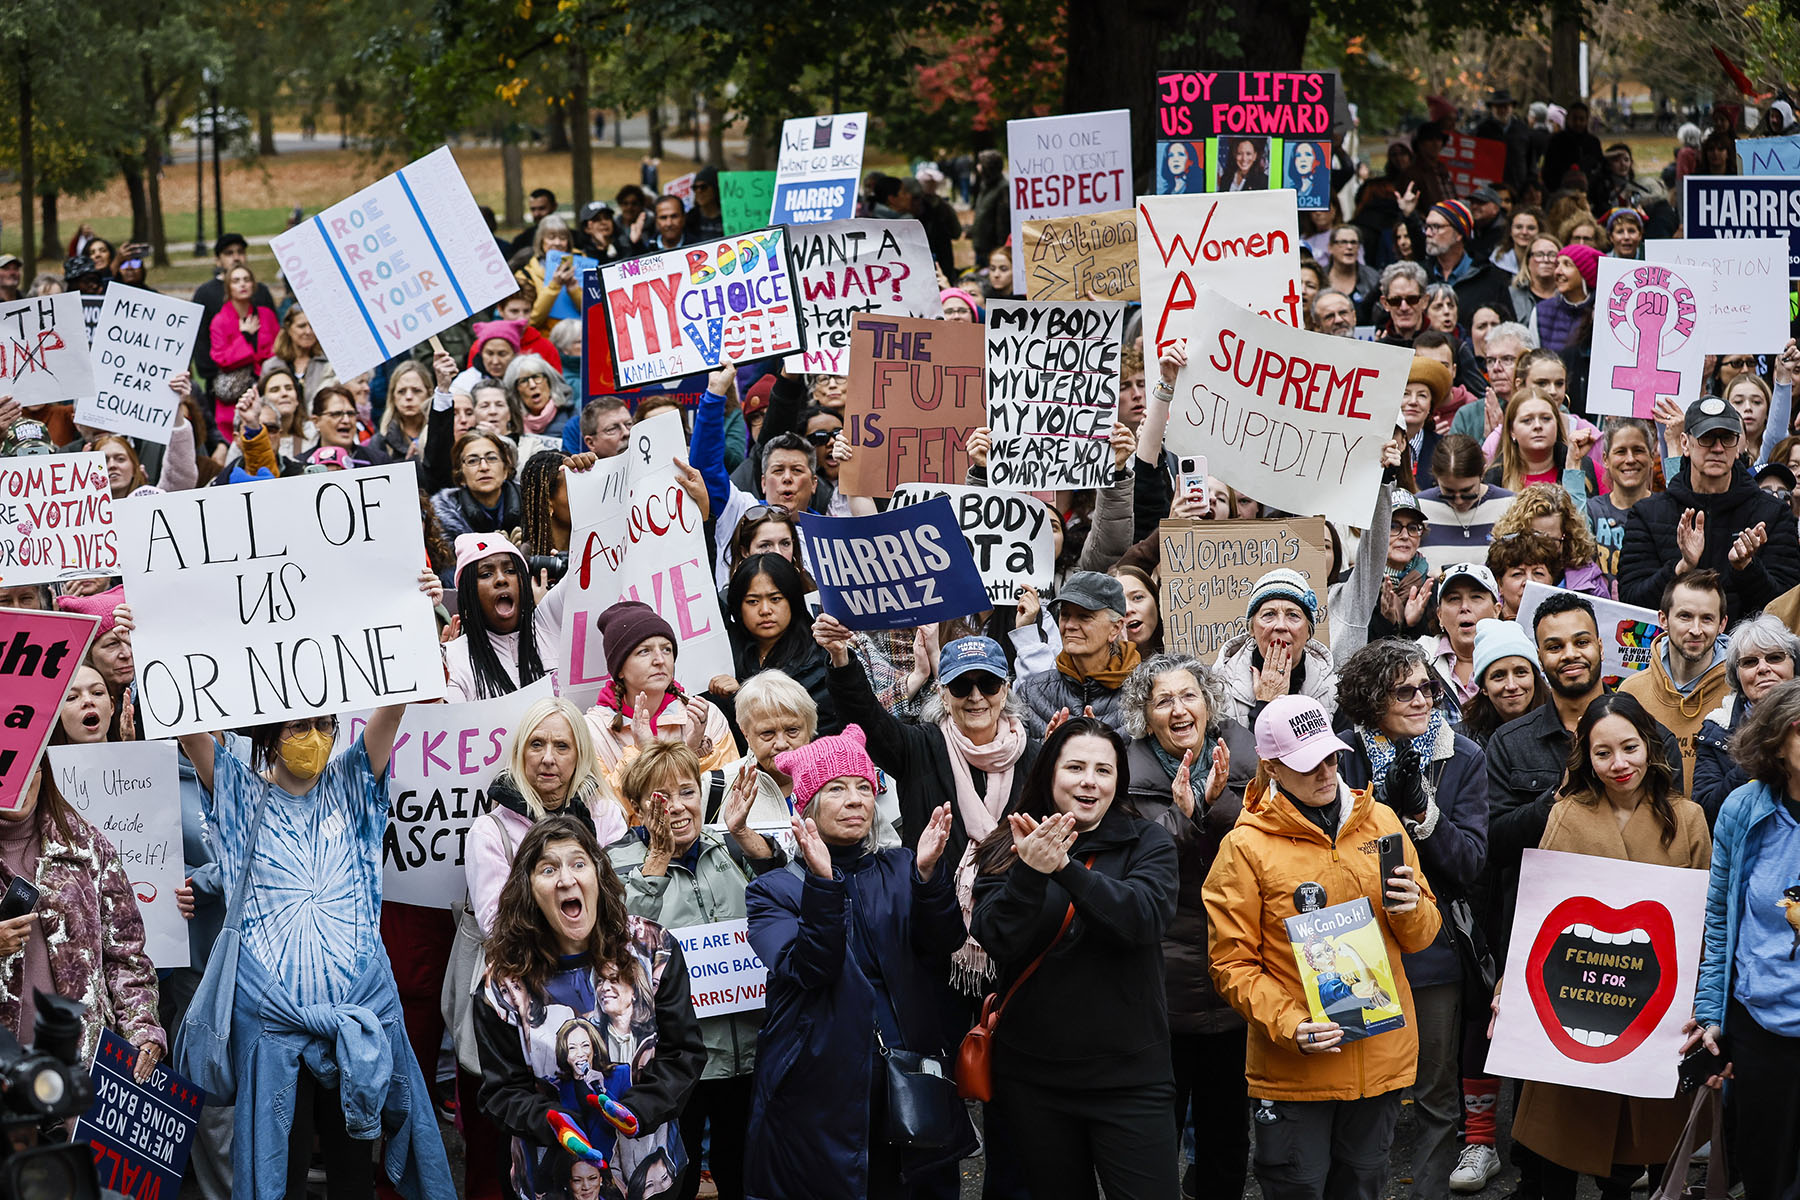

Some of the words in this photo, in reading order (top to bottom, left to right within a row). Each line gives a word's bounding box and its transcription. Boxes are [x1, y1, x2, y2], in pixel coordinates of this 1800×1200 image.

[1158, 73, 1218, 103] JOY
[1239, 72, 1323, 102] LIFTS
[1160, 106, 1193, 135] US
[1212, 104, 1329, 134] FORWARD
[785, 128, 810, 152] WE
[1037, 133, 1063, 150] NO
[1069, 131, 1101, 146] ONE
[810, 156, 827, 170] GO
[831, 153, 860, 168] BACK
[1015, 157, 1054, 175] WHO
[1063, 151, 1118, 172] DOESN'T
[785, 186, 845, 211] HARRIS
[1015, 169, 1124, 210] RESPECT
[1297, 196, 1321, 207] 024
[331, 198, 384, 239] ROE
[793, 209, 833, 223] WALZ
[344, 223, 397, 265] ROE
[877, 229, 901, 259] A
[1032, 220, 1137, 263] Action
[1139, 201, 1290, 268] Women
[275, 241, 312, 290] NOT
[357, 250, 410, 291] ROE
[474, 240, 514, 290] NOT
[685, 231, 783, 285] BODY
[371, 269, 439, 314] YOUR
[803, 261, 910, 302] WAP?
[1073, 255, 1138, 299] Fear
[115, 299, 155, 321] MEN
[166, 313, 189, 328] OF
[384, 294, 453, 340] VOTE
[608, 272, 682, 362] MY
[681, 272, 788, 321] CHOICE
[1609, 281, 1633, 328] YES
[1634, 266, 1672, 289] SHE
[1673, 287, 1697, 338] CAN
[108, 326, 184, 356] QUALITY
[683, 305, 792, 366] VOTE
[857, 320, 933, 363] THE
[991, 307, 1048, 334] MY
[1047, 307, 1120, 341] BODY
[101, 350, 125, 368] DO
[137, 362, 172, 380] NOT
[624, 358, 668, 384] KAMALA
[669, 355, 684, 374] 24
[803, 348, 843, 372] MY
[989, 336, 1028, 365] MY
[1026, 339, 1119, 373] CHOICE
[113, 372, 151, 392] FEAR
[872, 361, 985, 411] FUT
[989, 368, 1024, 400] MY
[1025, 370, 1118, 408] UTERUS
[1209, 329, 1379, 420] SUPREME
[96, 391, 172, 427] EQUALITY
[989, 402, 1029, 435] MY
[1036, 405, 1112, 438] VOICE
[850, 413, 885, 448] IS
[1185, 383, 1363, 484] STUPIDITY
[990, 437, 1021, 461] WE
[1022, 437, 1070, 464] ARE
[1074, 438, 1112, 466] NOT
[992, 461, 1116, 488] OVARY-ACTING
[25, 493, 113, 529] VOTING
[144, 492, 287, 572] ALL
[315, 475, 391, 546] OF
[960, 493, 1045, 541] BODY
[19, 537, 54, 567] OUR
[812, 524, 950, 587] HARRIS
[1006, 541, 1034, 575] a
[1164, 530, 1300, 573] Women's
[237, 562, 307, 625] US
[840, 578, 944, 616] WALZ
[1168, 575, 1253, 612] Rights
[142, 653, 229, 727] OR
[245, 625, 417, 715] NONE
[1622, 654, 1634, 662] GO
[4, 705, 35, 729] a
[1289, 709, 1322, 729] KAMALA
[1293, 717, 1327, 737] HARRIS
[62, 766, 90, 810] My
[103, 769, 152, 797] Uterus
[103, 813, 144, 834] decide
[16, 887, 31, 902] 3:05
[702, 933, 730, 949] ARE
[1296, 922, 1314, 938] We
[1314, 917, 1336, 933] Can
[1335, 912, 1352, 927] Do
[688, 961, 728, 979] OING
[1565, 947, 1644, 971] FEMINISM
[1582, 970, 1597, 983] IS
[1602, 973, 1626, 987] FOR
[1559, 986, 1637, 1008] EVERYBODY
[96, 1074, 139, 1116] BACK
[95, 1103, 128, 1137] NOT
[141, 1101, 186, 1143] GOING
[130, 1121, 175, 1164] WE'RE
